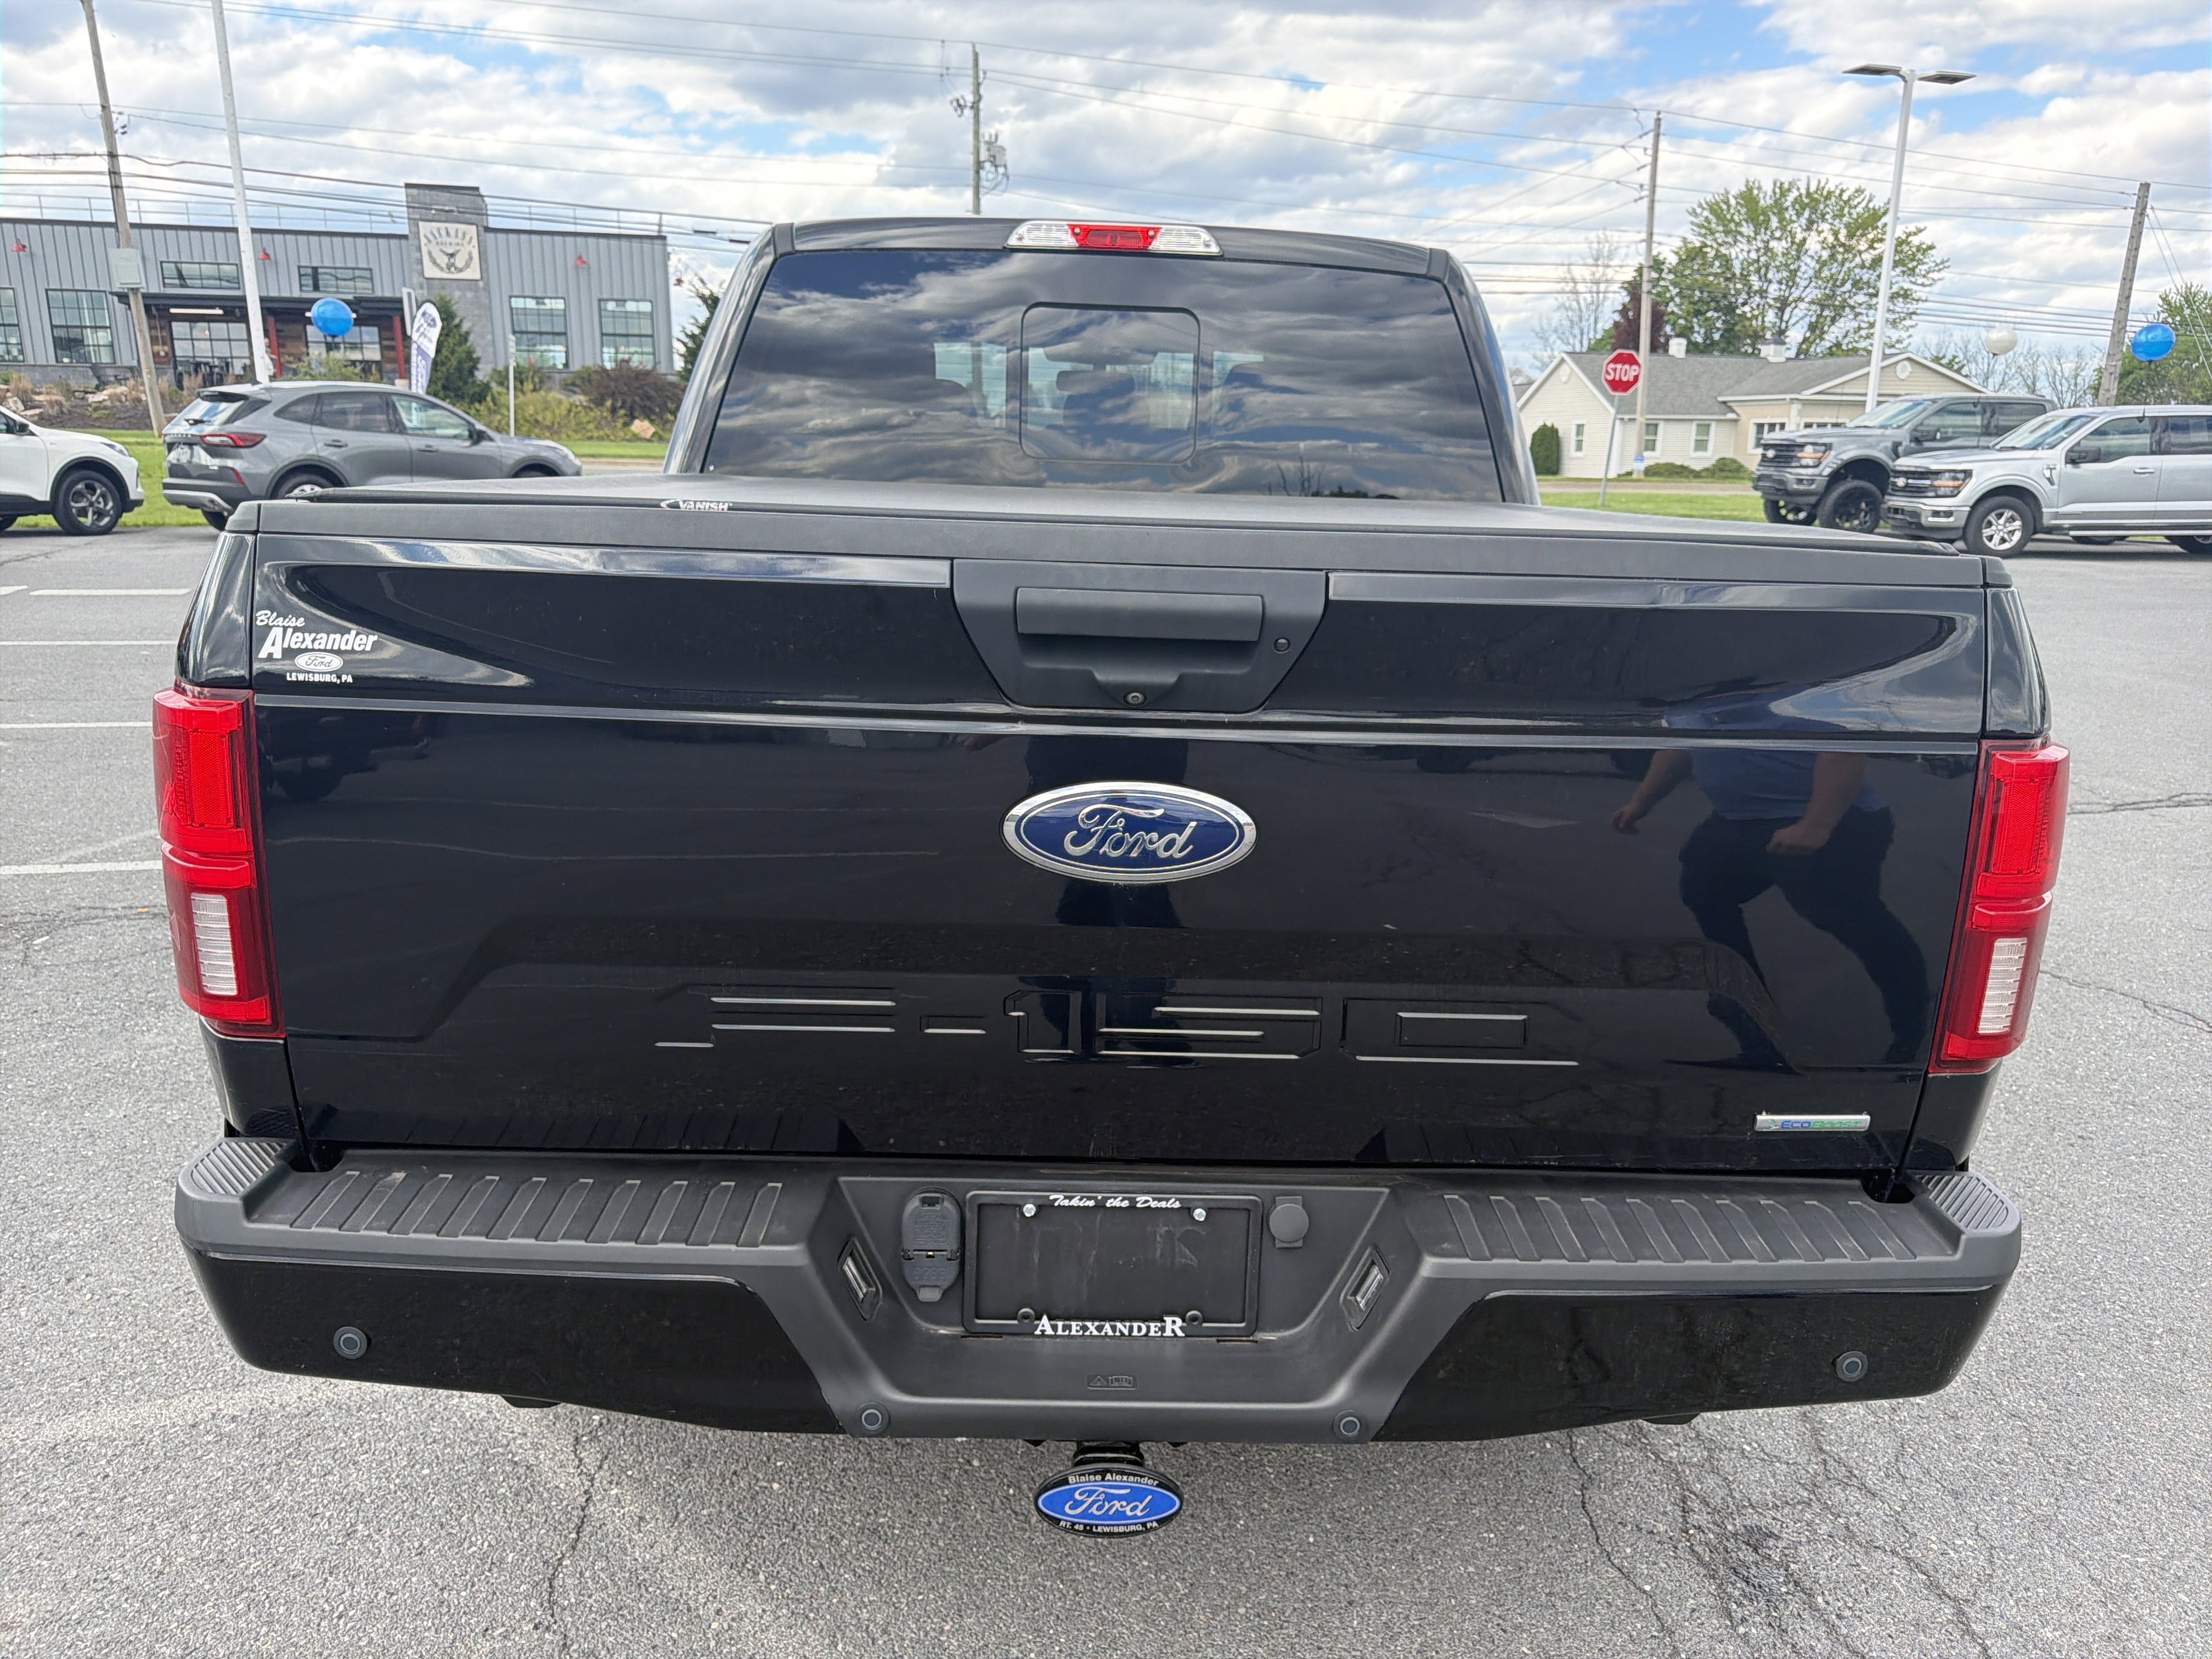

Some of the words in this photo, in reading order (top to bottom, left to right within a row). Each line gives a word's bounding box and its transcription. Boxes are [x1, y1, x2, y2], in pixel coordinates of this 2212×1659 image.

[1605, 363, 1639, 381] STOP
[679, 500, 729, 511] VANISH
[256, 610, 305, 627] Blaise
[258, 627, 378, 658] Alexander
[305, 655, 334, 668] Ford
[286, 673, 340, 684] LEWISBURG,
[342, 674, 353, 683] PA
[1064, 804, 1197, 858] Ford
[1049, 1194, 1102, 1207] Takin'
[1106, 1195, 1129, 1208] the
[1136, 1196, 1181, 1209] Deals
[1034, 1314, 1186, 1338] ALEXANDER
[1068, 1473, 1102, 1484] Blaise
[1104, 1472, 1159, 1486] Alexander
[1065, 1487, 1154, 1516] Ford
[1059, 1520, 1071, 1529] RT.
[1092, 1524, 1145, 1532] LEWISBURG,
[1147, 1521, 1159, 1529] PA
